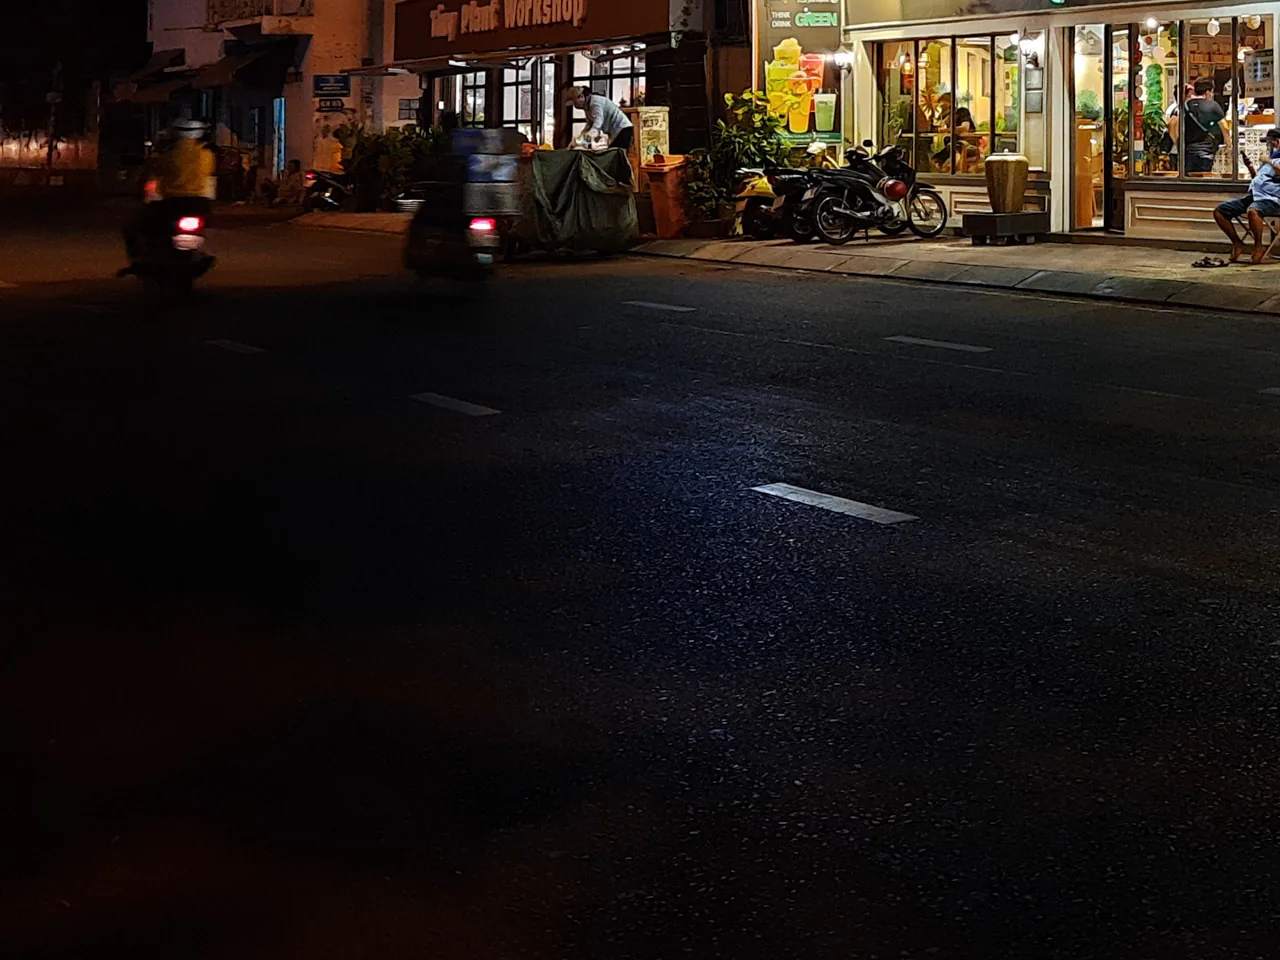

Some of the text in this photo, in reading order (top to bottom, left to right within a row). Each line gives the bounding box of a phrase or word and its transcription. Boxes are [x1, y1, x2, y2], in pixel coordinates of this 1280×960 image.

[460, 0, 500, 35] Plant
[771, 11, 838, 27] THINK GREEN
